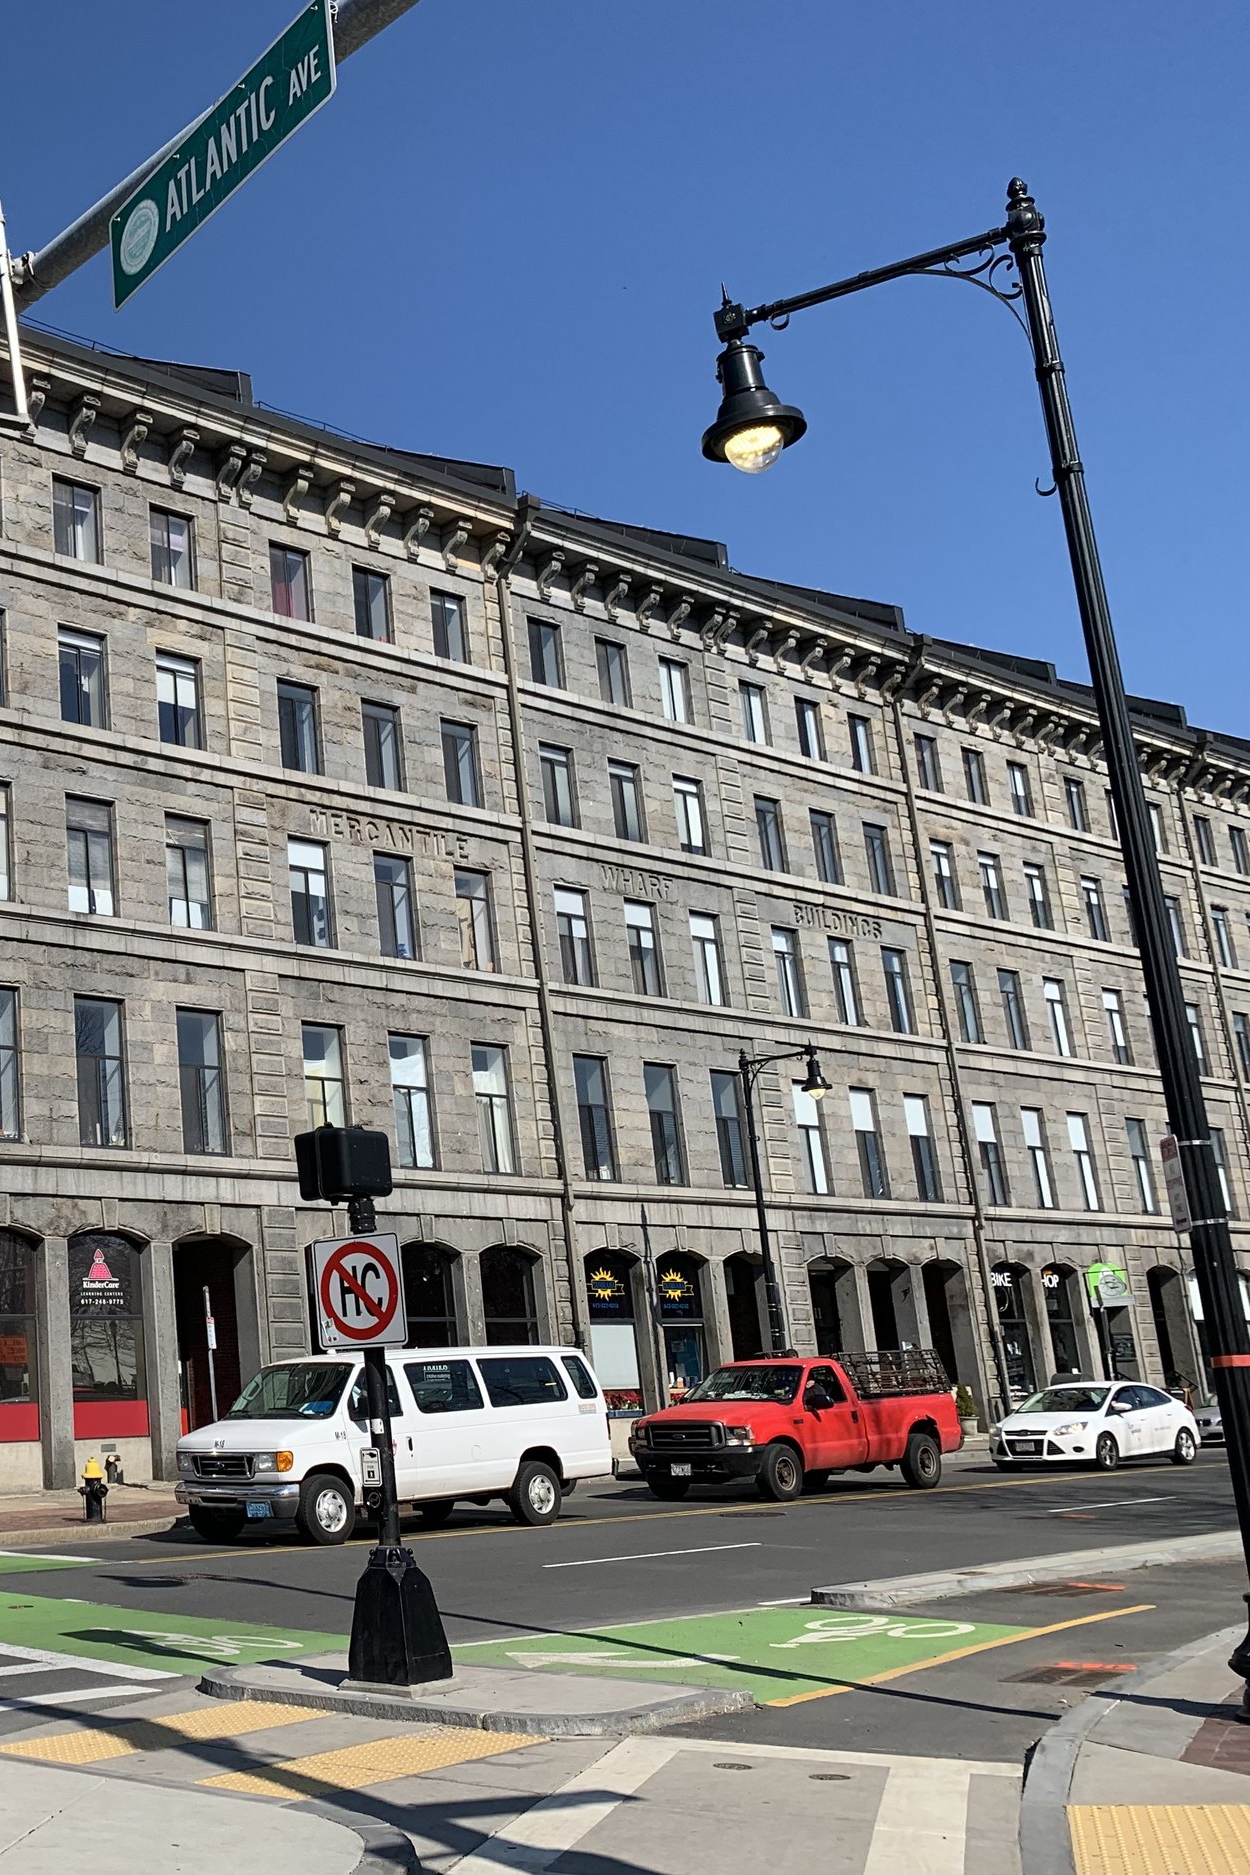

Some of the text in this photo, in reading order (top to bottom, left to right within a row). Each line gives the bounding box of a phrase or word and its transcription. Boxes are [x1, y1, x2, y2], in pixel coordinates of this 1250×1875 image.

[165, 44, 322, 233] ATLANTIC AVE
[309, 807, 470, 862] MERCANTILE
[601, 865, 673, 899] WHARF
[82, 1281, 120, 1289] KinderCare
[338, 1261, 383, 1318] HC
[990, 1272, 1013, 1287] BIKE
[1040, 1273, 1060, 1288] HOP
